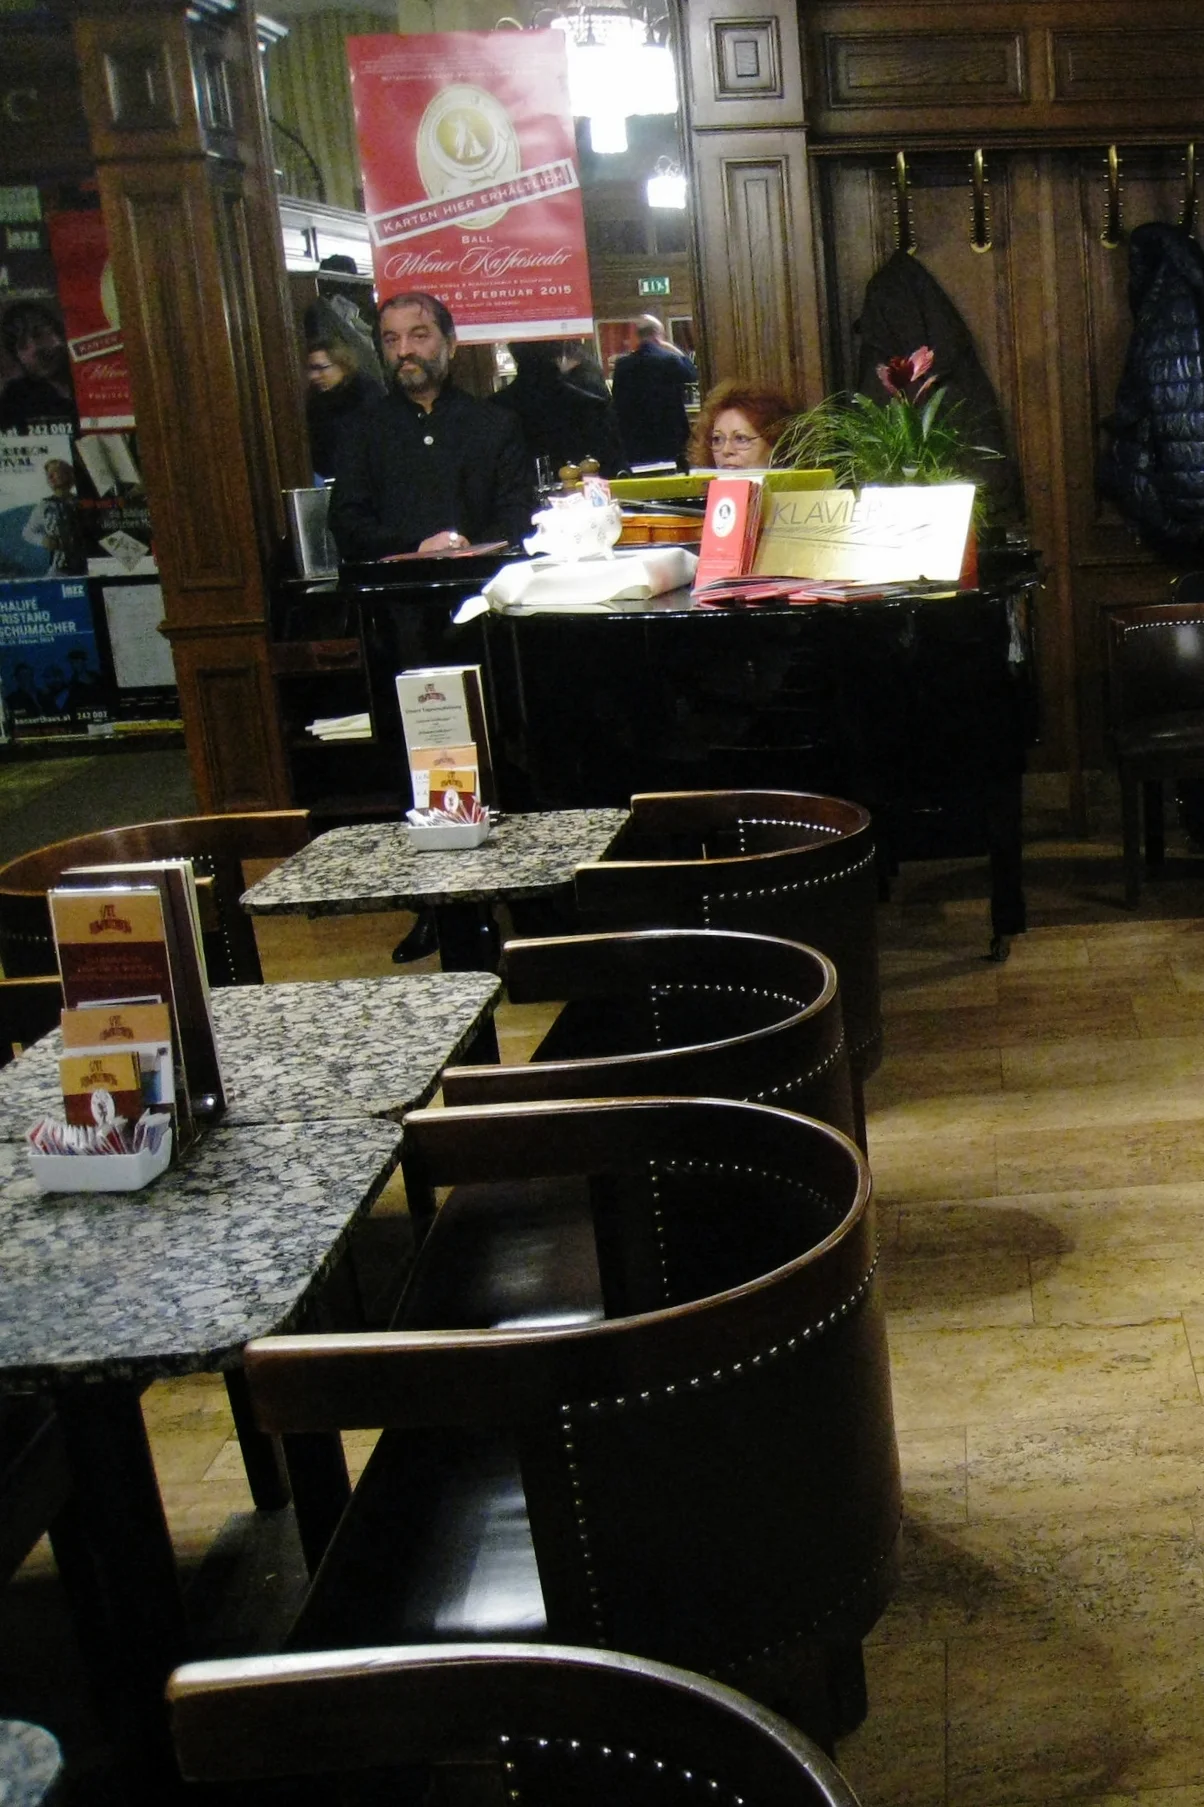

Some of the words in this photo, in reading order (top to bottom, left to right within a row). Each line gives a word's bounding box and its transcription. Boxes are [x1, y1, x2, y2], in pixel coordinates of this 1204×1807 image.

[384, 209, 438, 233] KARTEN
[443, 199, 475, 216] HIER
[461, 235, 494, 244] BALL
[384, 249, 461, 279] Wiener
[473, 288, 534, 300] FEBRUAR
[540, 285, 572, 296] 2015
[0, 598, 38, 611] HALIFÉ
